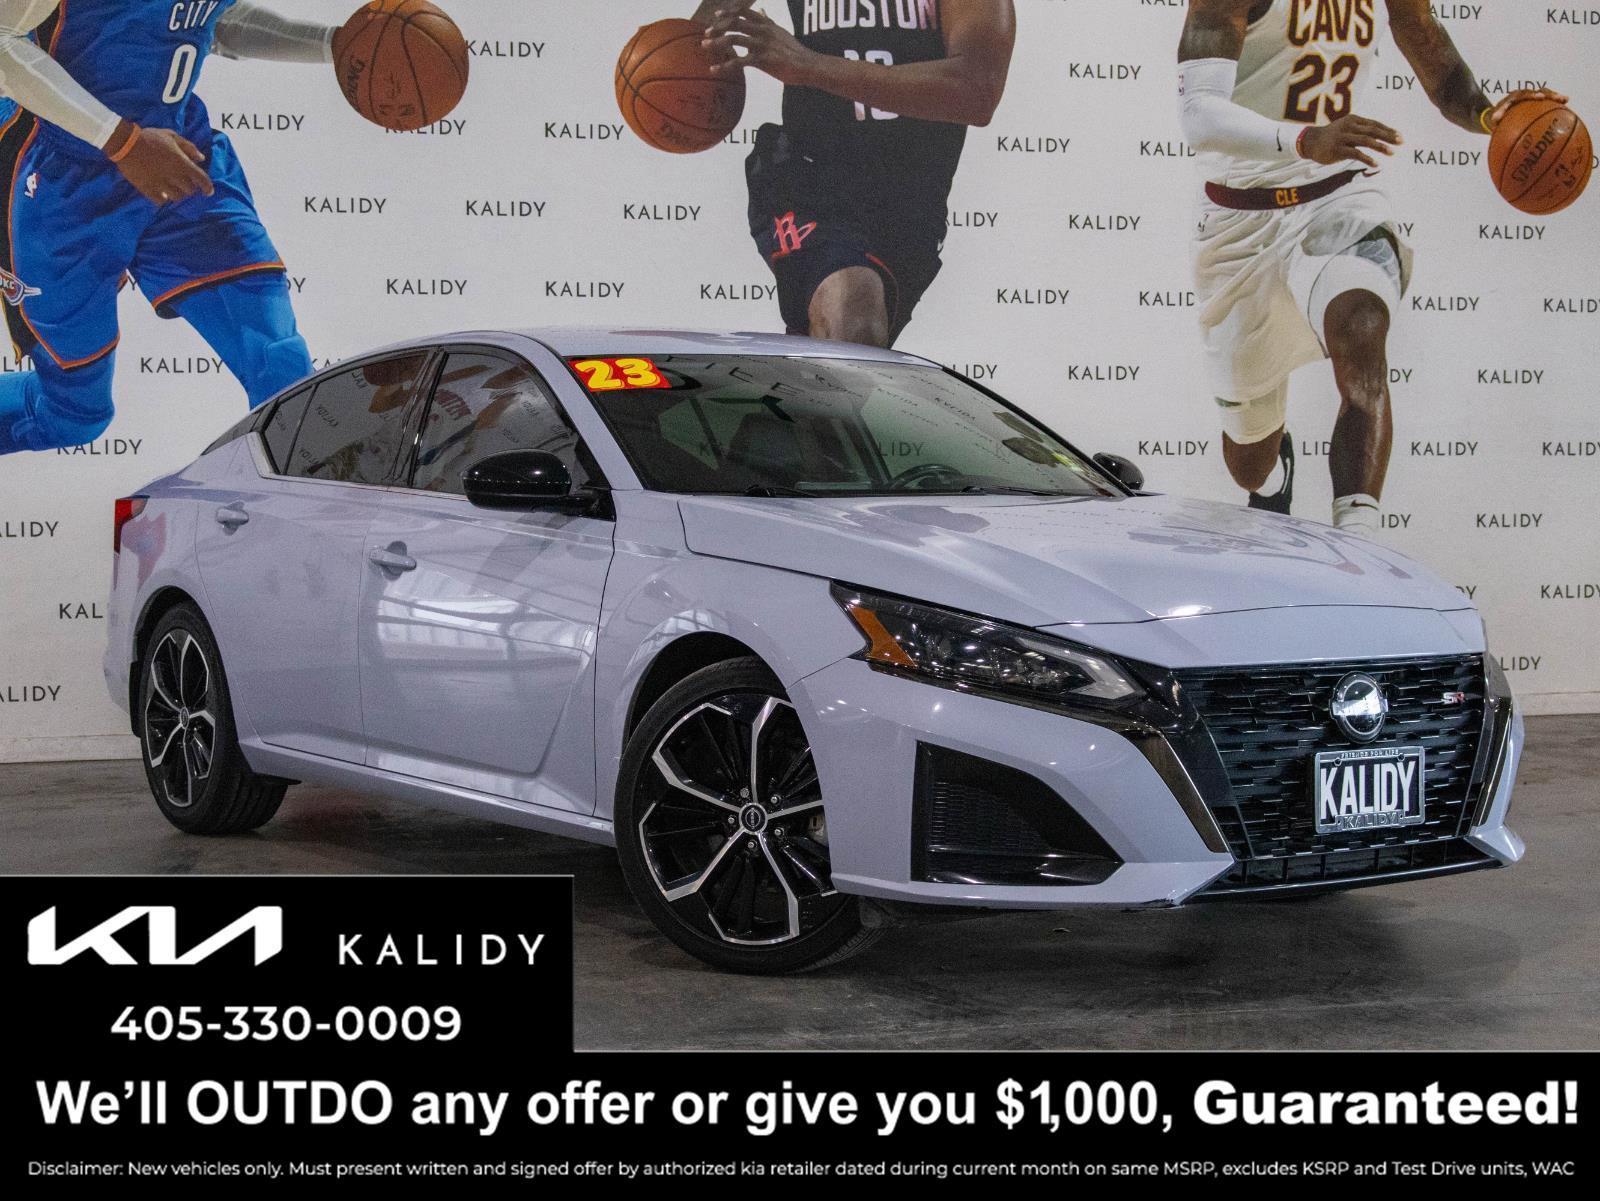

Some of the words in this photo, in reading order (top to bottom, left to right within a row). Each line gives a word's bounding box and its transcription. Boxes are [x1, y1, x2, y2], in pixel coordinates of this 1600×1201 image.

[168, 0, 219, 31] CITY
[1430, 5, 1482, 20] ALIDY
[1547, 9, 1600, 25] KALID
[1286, 0, 1374, 48] CAVS
[466, 40, 545, 58] KALIDY
[162, 44, 198, 104] 0
[1069, 63, 1142, 80] KALIDY
[1283, 51, 1360, 124] 23
[221, 113, 305, 131] KALIDY
[544, 122, 625, 140] KALIDY
[997, 136, 1071, 153] KALIDY
[1414, 150, 1481, 166] KALIDY
[304, 196, 387, 214] KALIDY
[1275, 187, 1299, 207] CLE
[466, 200, 546, 217] KALIDY
[623, 204, 701, 221] KALIDY
[946, 212, 998, 228] LIDY
[1069, 214, 1141, 231] KALIDY
[1479, 225, 1546, 240] KALIDY
[386, 279, 468, 296] KALIDY
[545, 281, 625, 298] KALIDY
[700, 284, 778, 301] KALIDY
[997, 288, 1070, 305] KALIDY
[1139, 291, 1195, 307] KALID
[1412, 296, 1480, 311] KALIDY
[1543, 298, 1600, 313] KALID
[140, 357, 224, 374] KALIDY
[574, 357, 663, 391] 23
[1068, 365, 1140, 381] KALIDY
[1477, 369, 1544, 384] KALIDY
[879, 442, 924, 457] LIDY
[1138, 441, 1209, 456] KALIDY
[1302, 441, 1332, 456] LID
[1411, 441, 1478, 456] KALIDY
[1381, 513, 1411, 528] IDY
[1476, 513, 1543, 528] KALIDY
[0, 521, 59, 538] LIDY
[59, 602, 104, 619] KAL
[1500, 656, 1541, 671] LIDY
[0, 685, 62, 702] LIDY
[1320, 760, 1417, 820] KALIDY
[1342, 811, 1400, 829] KALIDY
